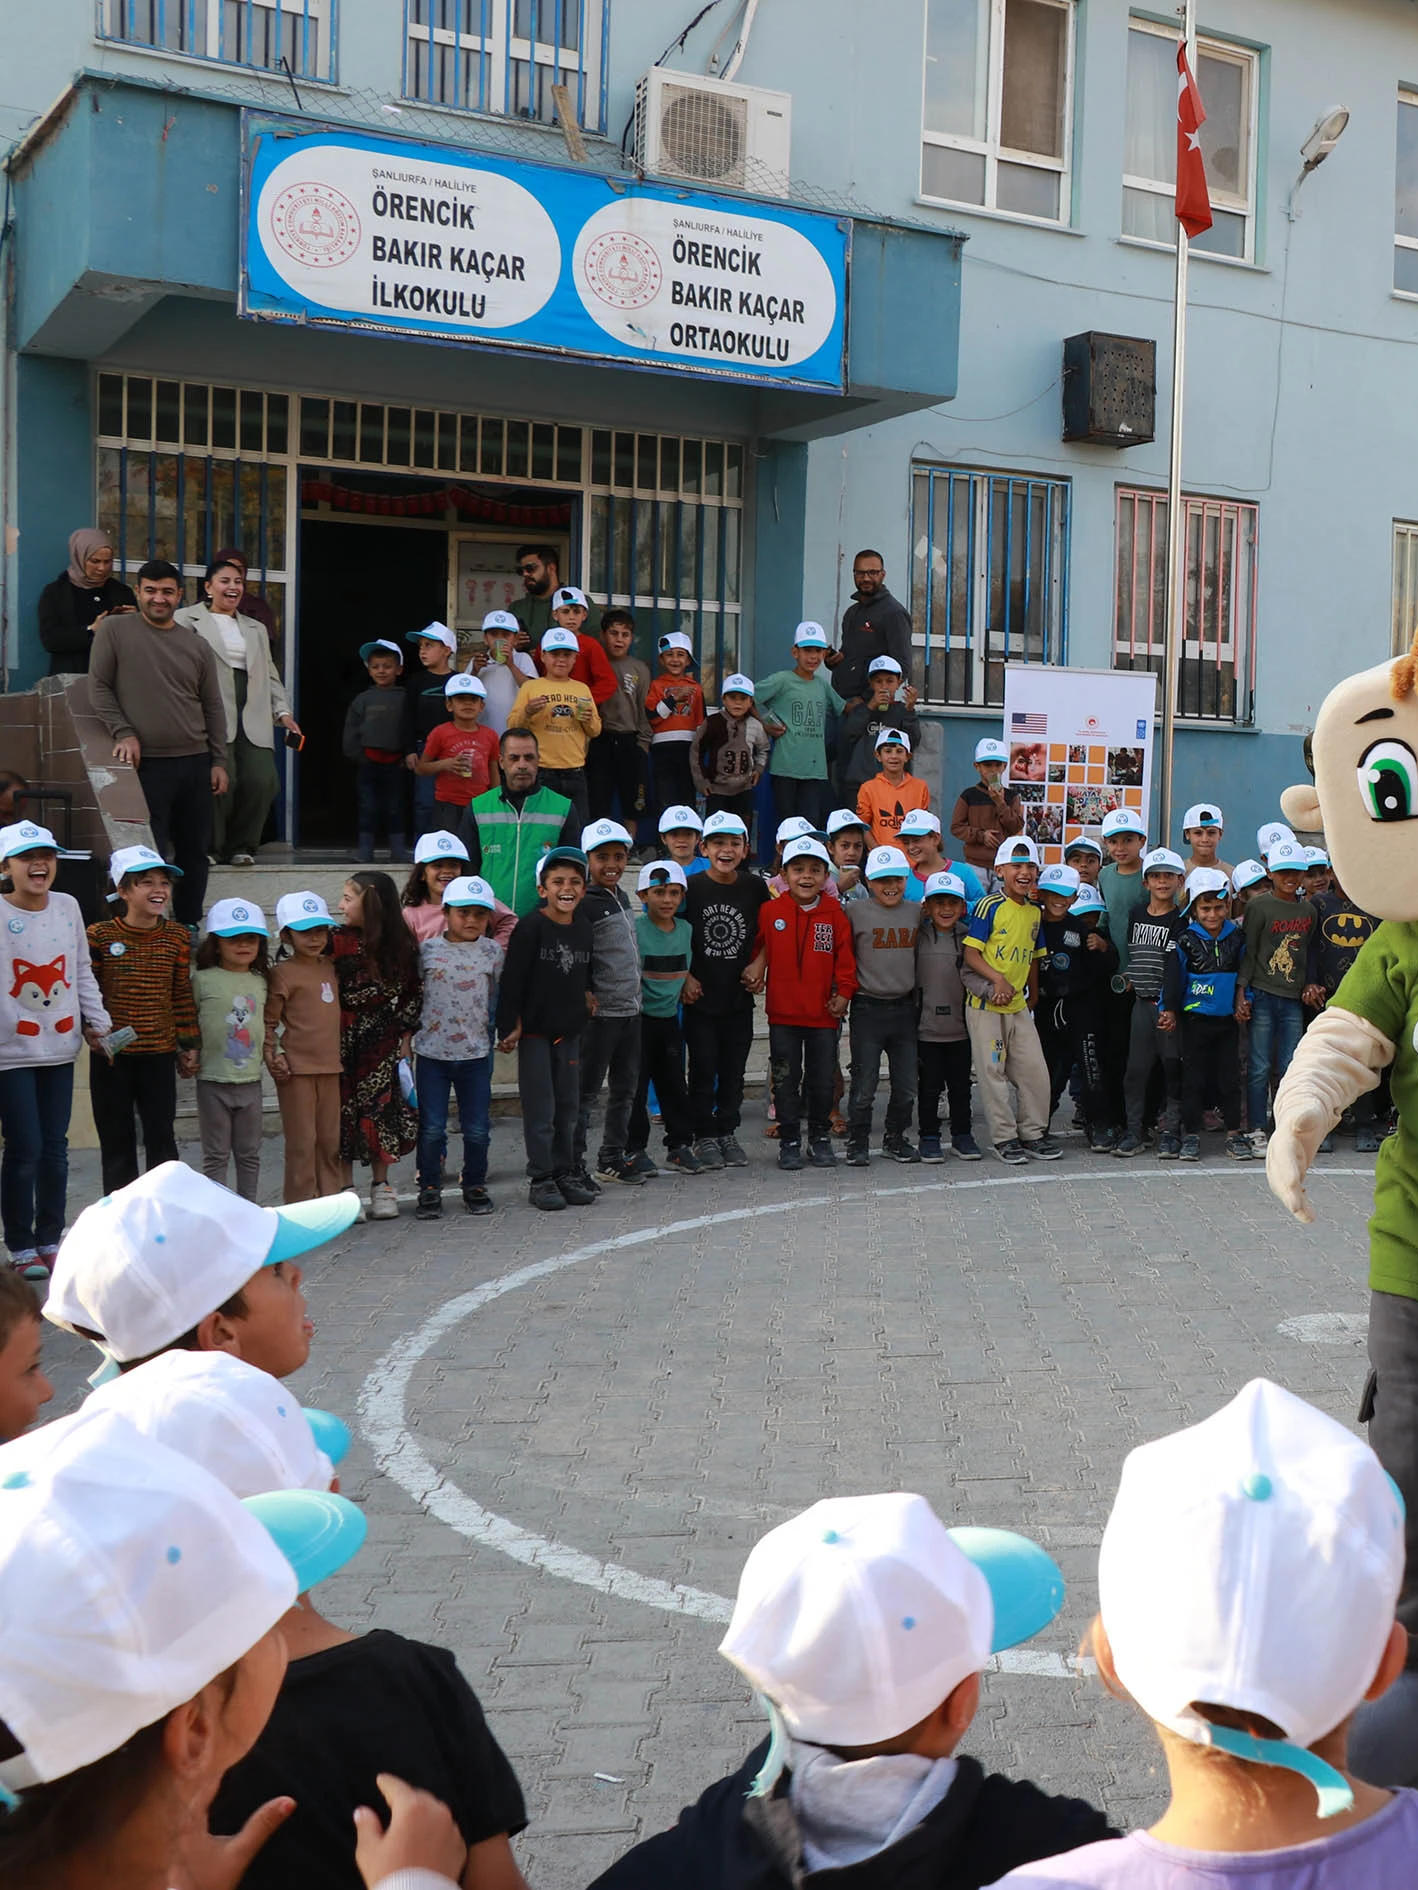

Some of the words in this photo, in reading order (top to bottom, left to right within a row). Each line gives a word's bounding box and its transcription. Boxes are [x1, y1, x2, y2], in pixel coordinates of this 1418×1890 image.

[372, 168, 428, 185] ŞANLIURFA
[434, 178, 478, 194] HALİLİYE
[372, 185, 476, 230] ÖRENCİK
[672, 218, 721, 235] ŞANLIURFA
[726, 228, 764, 242] HALİLİYE
[372, 235, 443, 270] BAKIR
[450, 246, 526, 284] KAÇAR
[672, 233, 762, 276] ÖRENCİK
[372, 274, 487, 320] İLKOKULU
[671, 280, 733, 313] BAKIR
[739, 290, 805, 326] KAÇAR
[669, 322, 790, 362] ORTAOKULU
